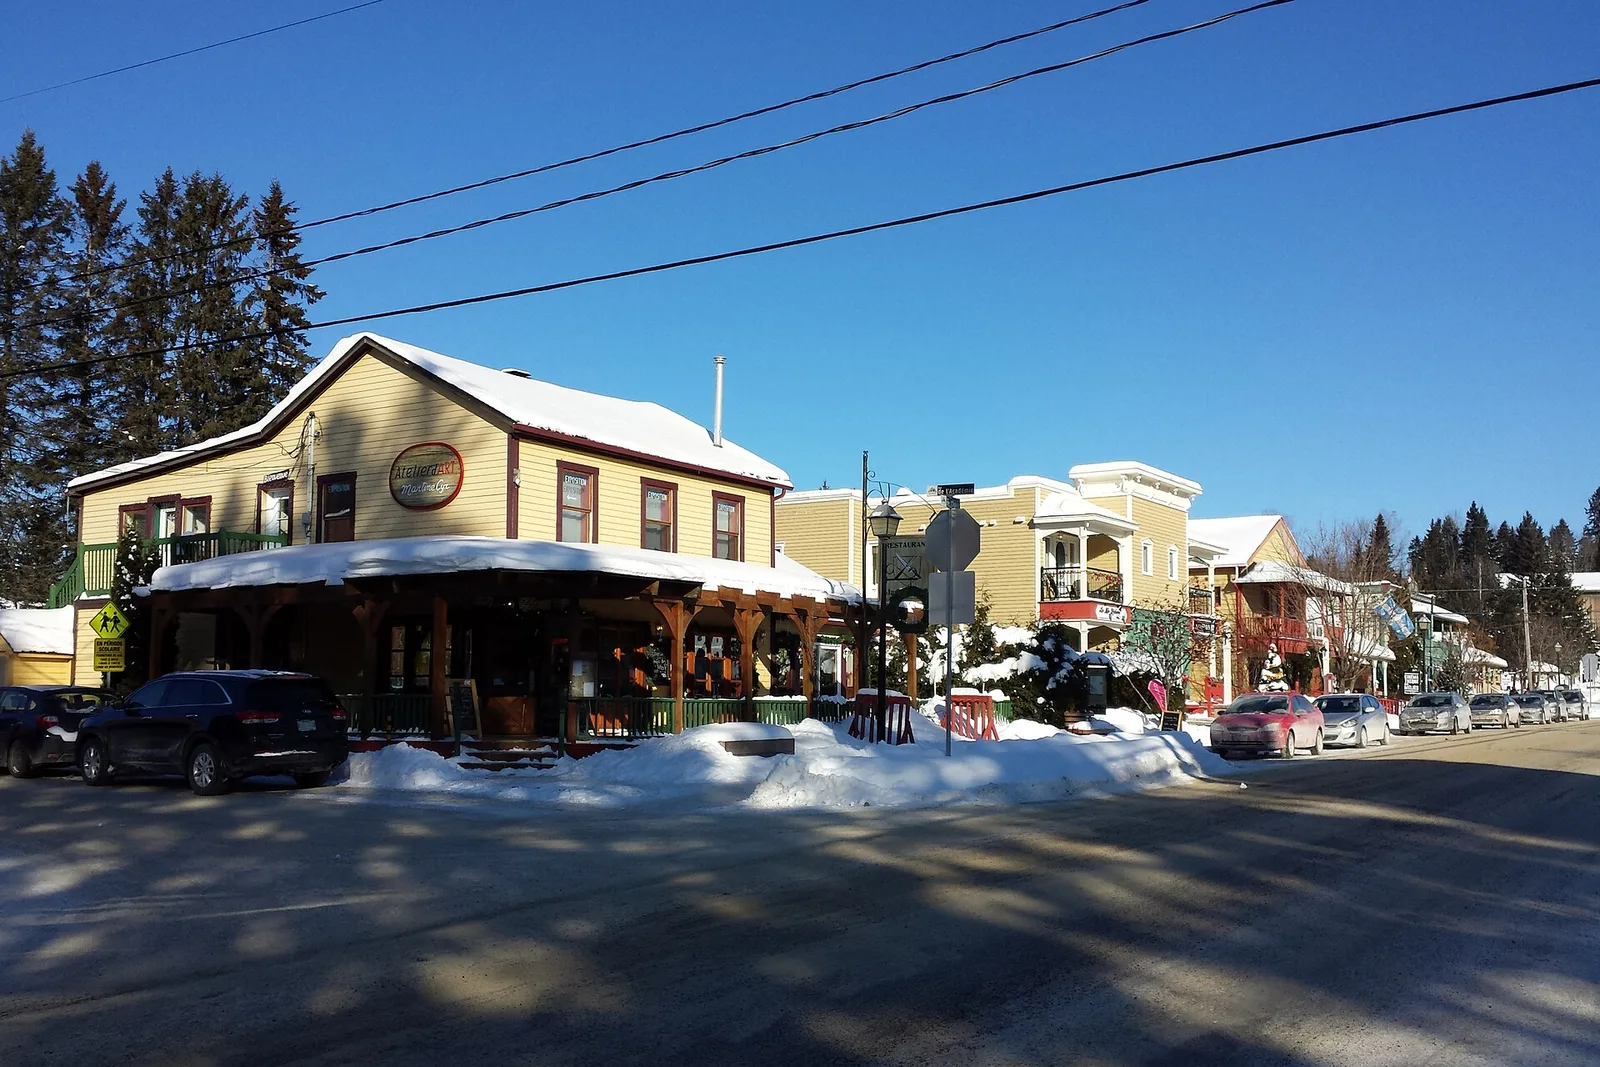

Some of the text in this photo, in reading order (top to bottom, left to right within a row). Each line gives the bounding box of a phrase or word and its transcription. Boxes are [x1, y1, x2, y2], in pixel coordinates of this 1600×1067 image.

[564, 475, 587, 486] EXPOSITION
[647, 491, 668, 501] EXPOSITION
[887, 541, 926, 549] RESTAURAN
